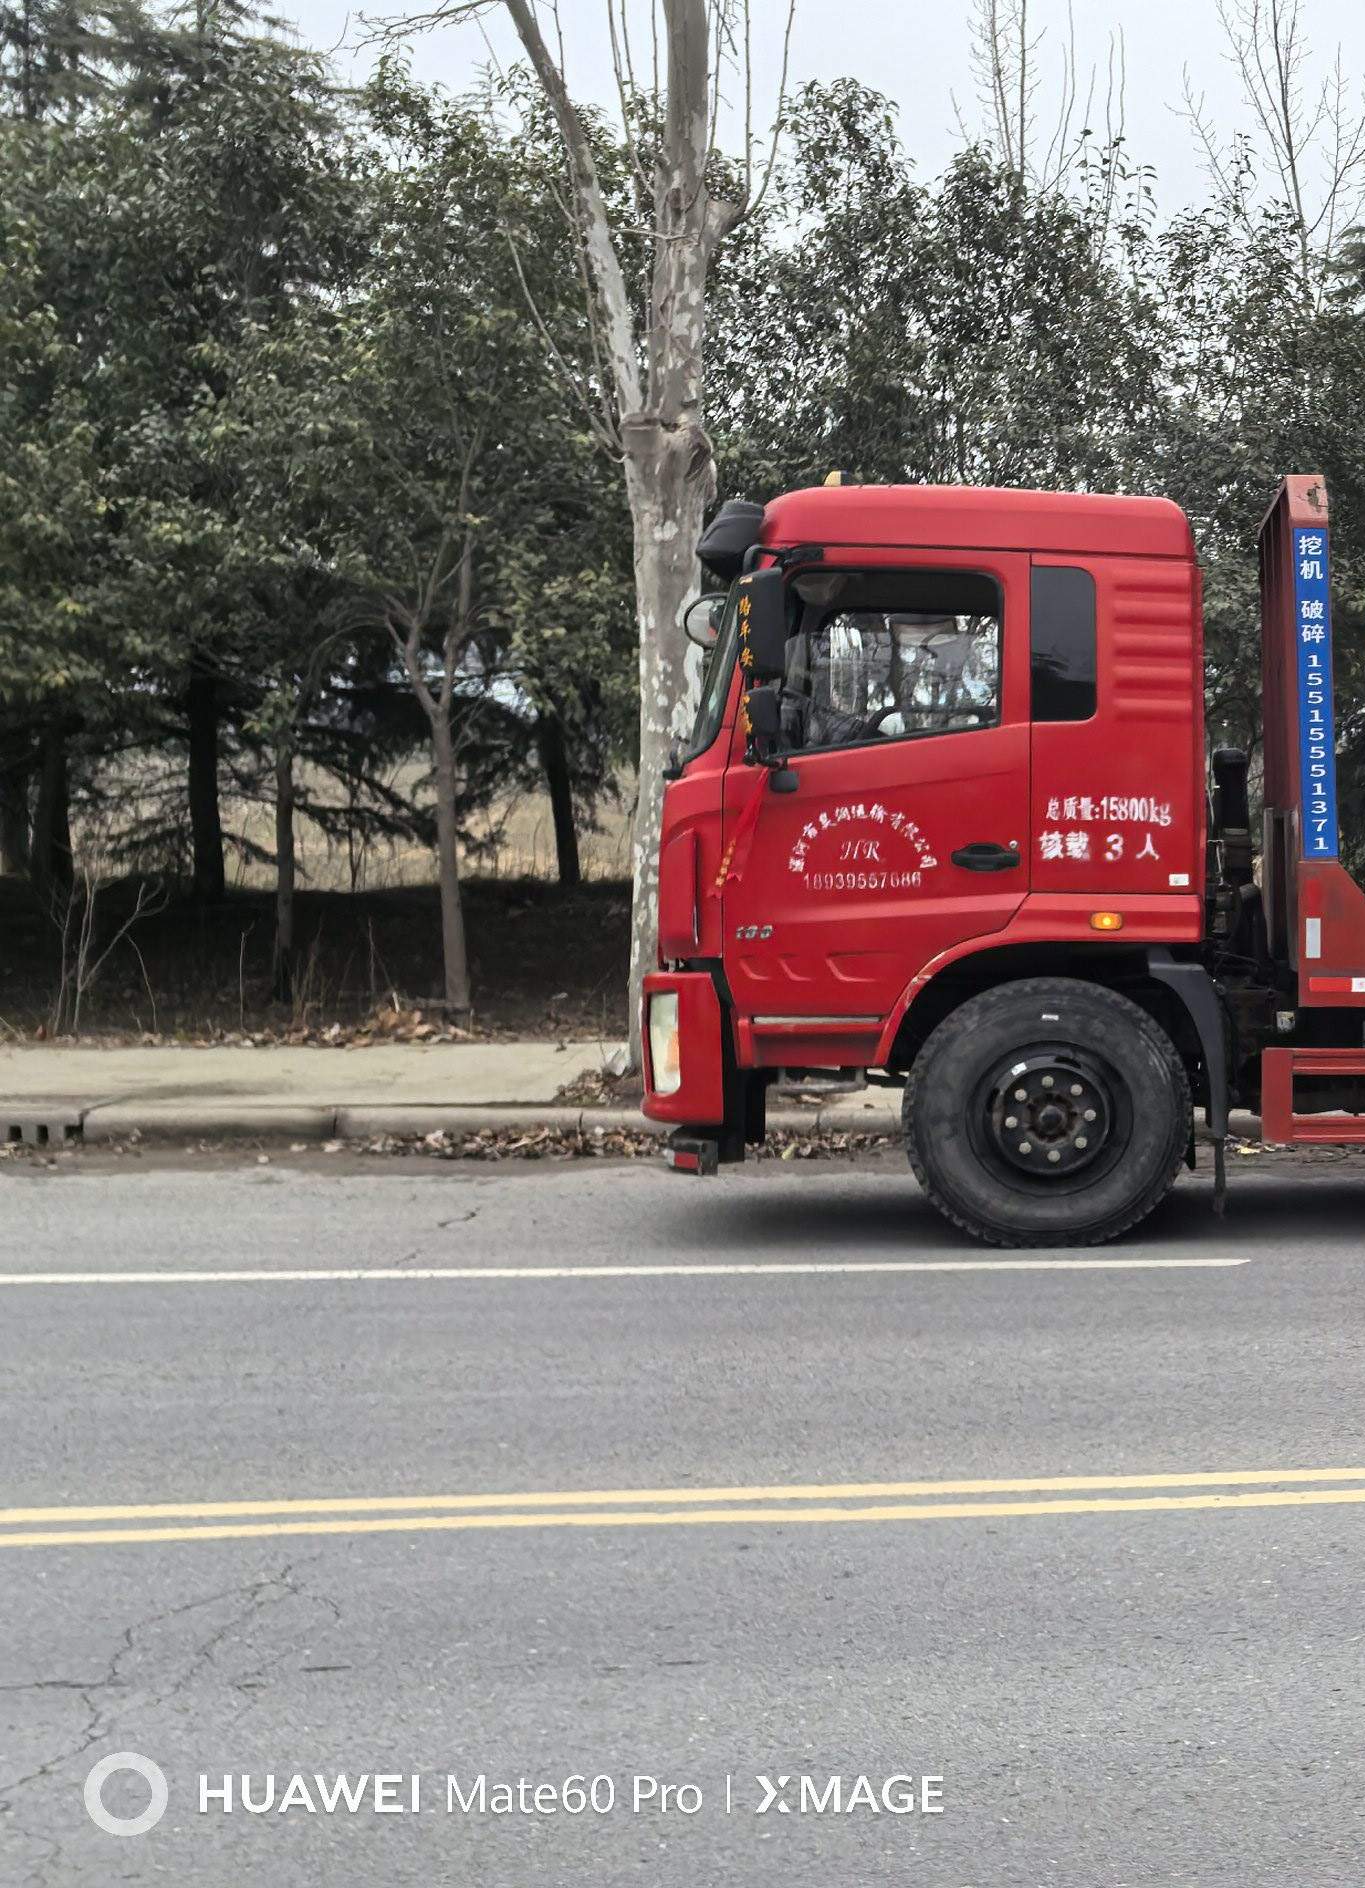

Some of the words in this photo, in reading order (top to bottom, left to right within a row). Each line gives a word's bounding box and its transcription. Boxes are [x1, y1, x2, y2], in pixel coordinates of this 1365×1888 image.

[1298, 535, 1323, 580] 挖机
[1300, 600, 1325, 643] 破碎
[1306, 654, 1329, 850] 15515551371
[1105, 833, 1124, 861] 3
[1136, 832, 1160, 861] 人
